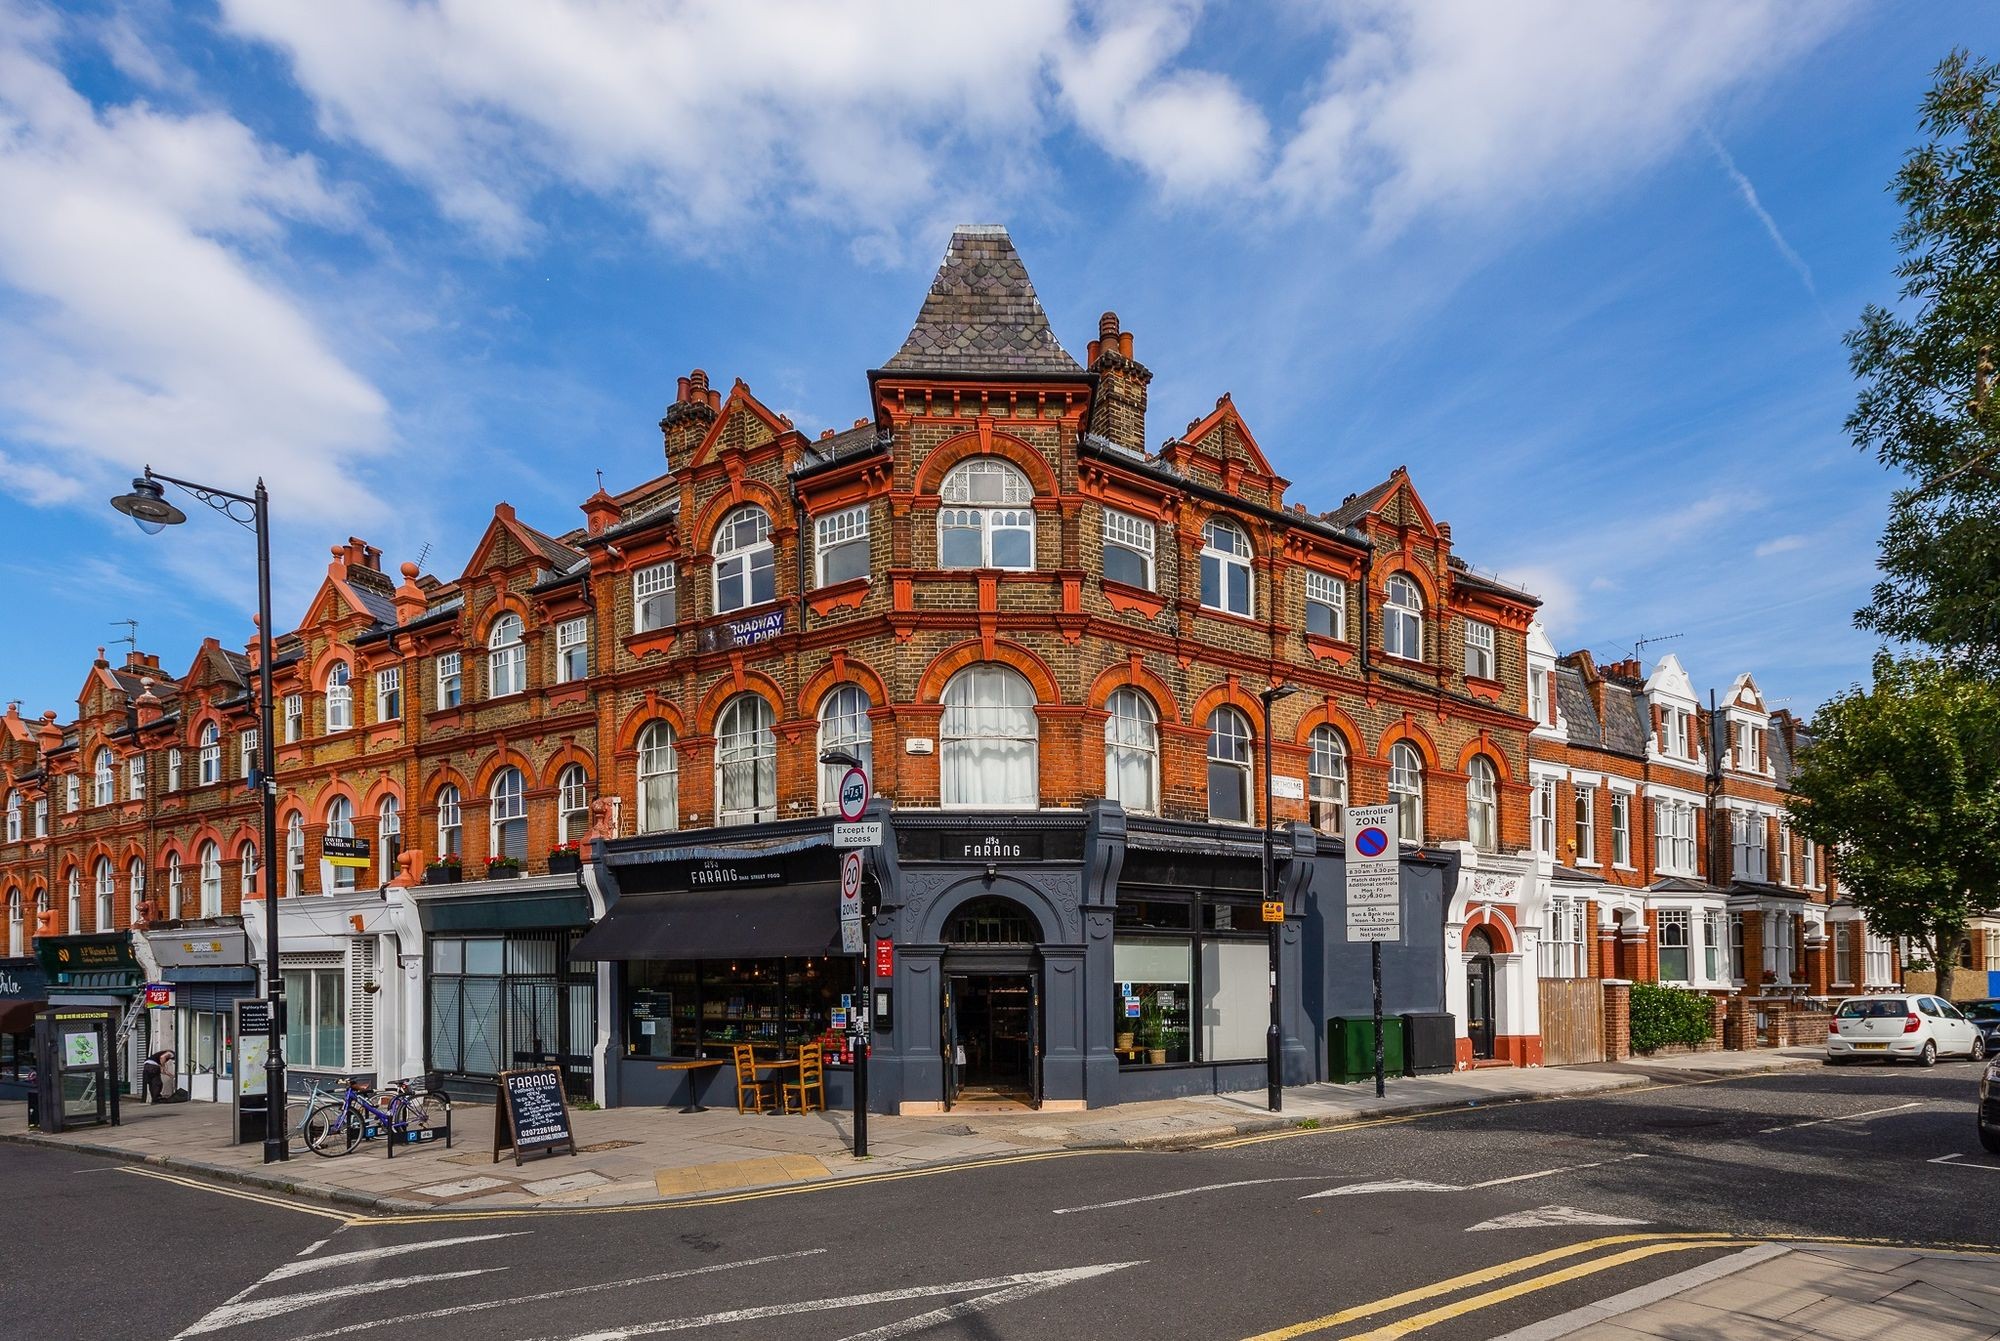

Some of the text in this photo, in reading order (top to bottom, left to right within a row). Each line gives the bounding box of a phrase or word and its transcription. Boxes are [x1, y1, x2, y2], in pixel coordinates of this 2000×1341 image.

[730, 613, 783, 636] ROADWAY
[754, 627, 782, 644] PARK
[1349, 807, 1394, 817] Controlled
[1356, 817, 1387, 826] ZONE
[837, 826, 879, 835] Except for
[964, 845, 1021, 857] FARANG
[691, 869, 738, 884] FARANG
[846, 866, 858, 886] 20
[842, 903, 859, 916] ZONE
[61, 1012, 105, 1020] TELEPHONE
[508, 1073, 557, 1090] FARANG
[410, 1132, 416, 1140] P
